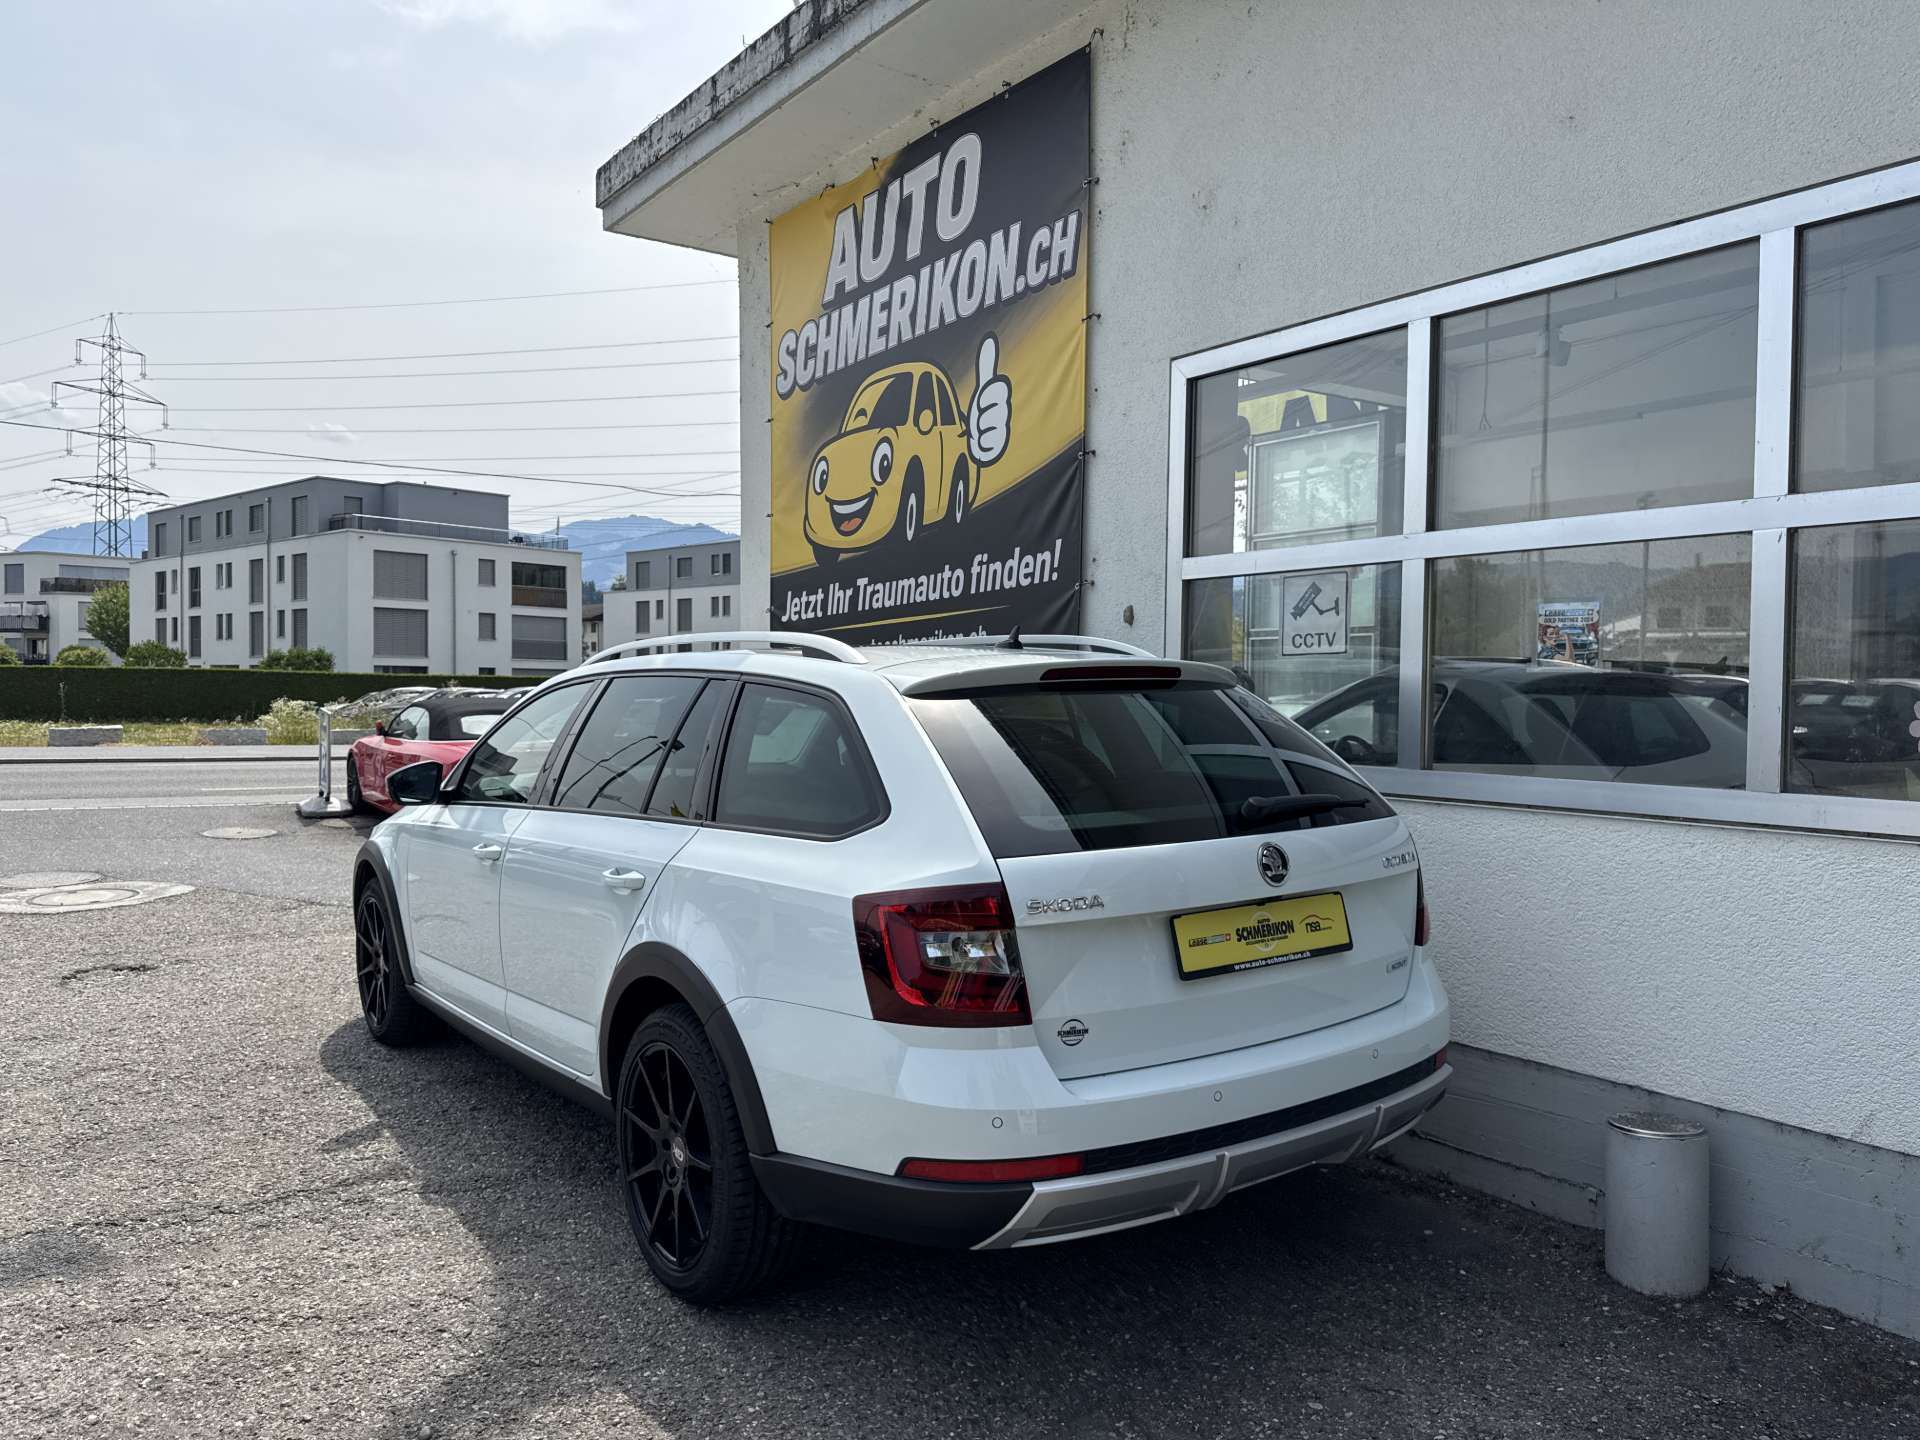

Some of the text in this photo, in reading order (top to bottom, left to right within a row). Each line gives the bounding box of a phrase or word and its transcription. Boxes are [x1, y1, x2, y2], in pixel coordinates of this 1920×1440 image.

[823, 132, 982, 305] AUTO
[777, 211, 1079, 396] SCHMERIKON.CH
[781, 538, 1063, 622] Jetzt Ihr Traumauto finden!
[1291, 632, 1336, 648] CCTV
[1236, 919, 1295, 943] SCHMERIKON
[1233, 951, 1311, 971] www.auto-schmerikon.ch
